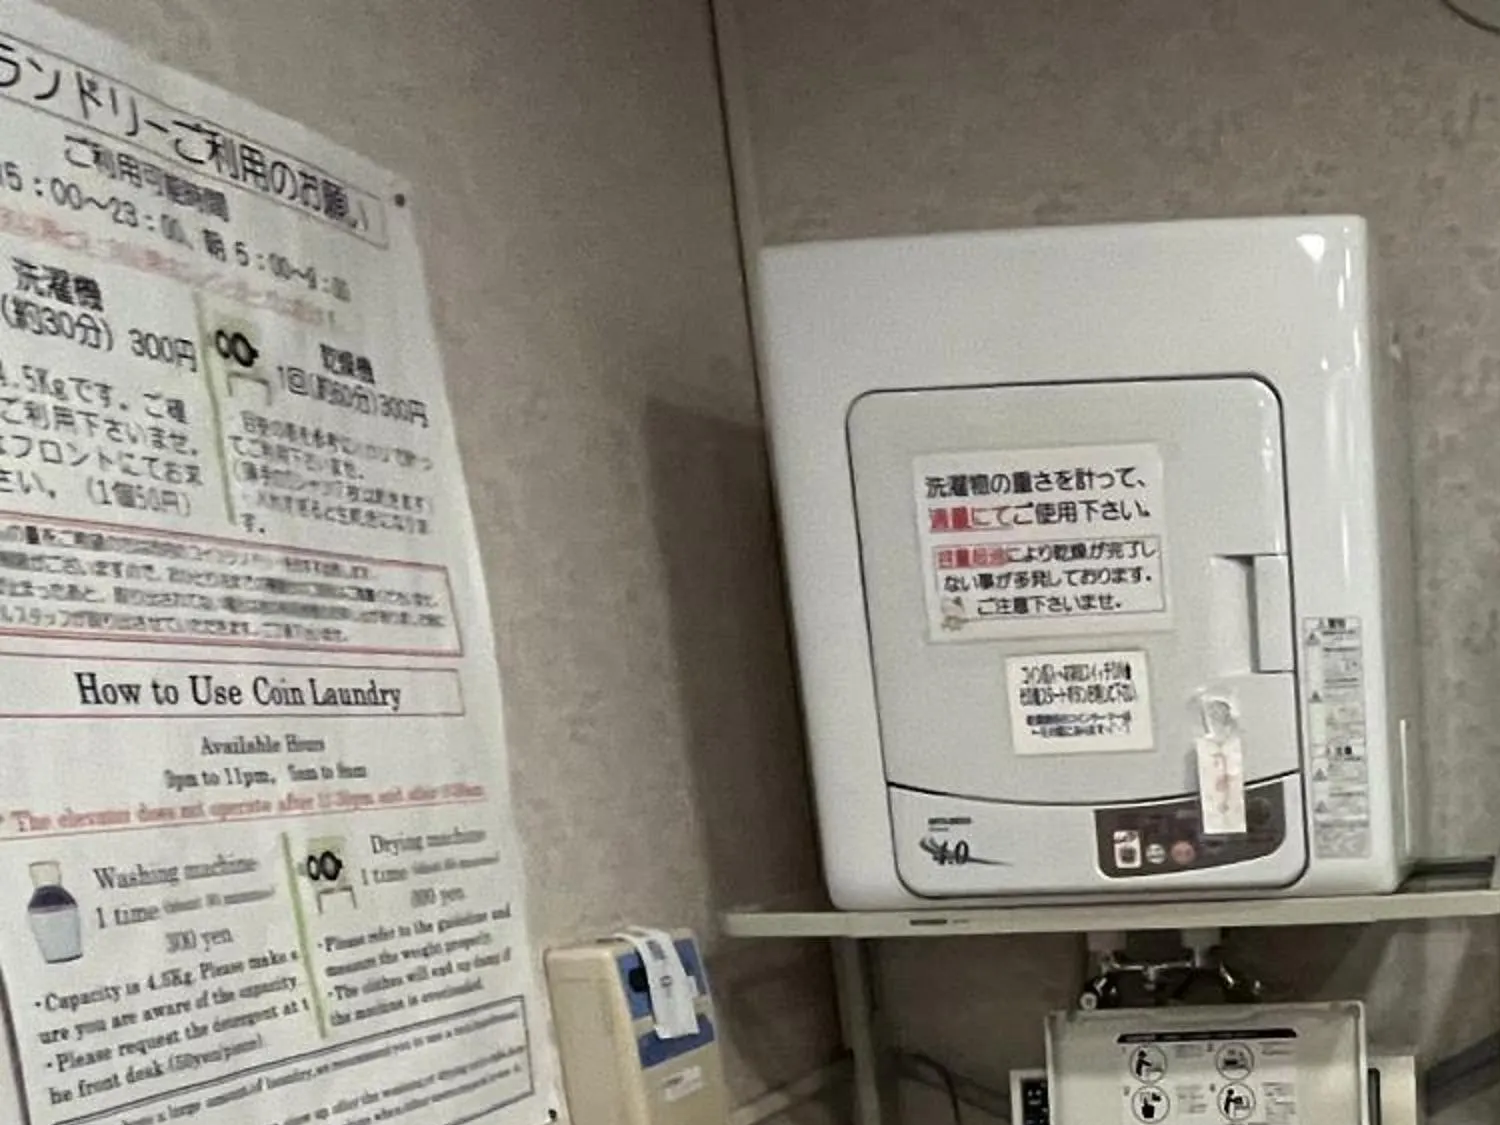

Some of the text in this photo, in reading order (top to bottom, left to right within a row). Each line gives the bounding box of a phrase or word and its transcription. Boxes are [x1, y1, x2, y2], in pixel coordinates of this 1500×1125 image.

[128, 328, 198, 373] 300円
[74, 671, 402, 712] How to Use Coin Laundry
[201, 736, 280, 755] Available
[202, 771, 220, 786] to
[93, 864, 179, 888] Washing
[45, 984, 121, 1012] Capacity
[56, 1046, 112, 1072] Please
[119, 1030, 181, 1057] request
